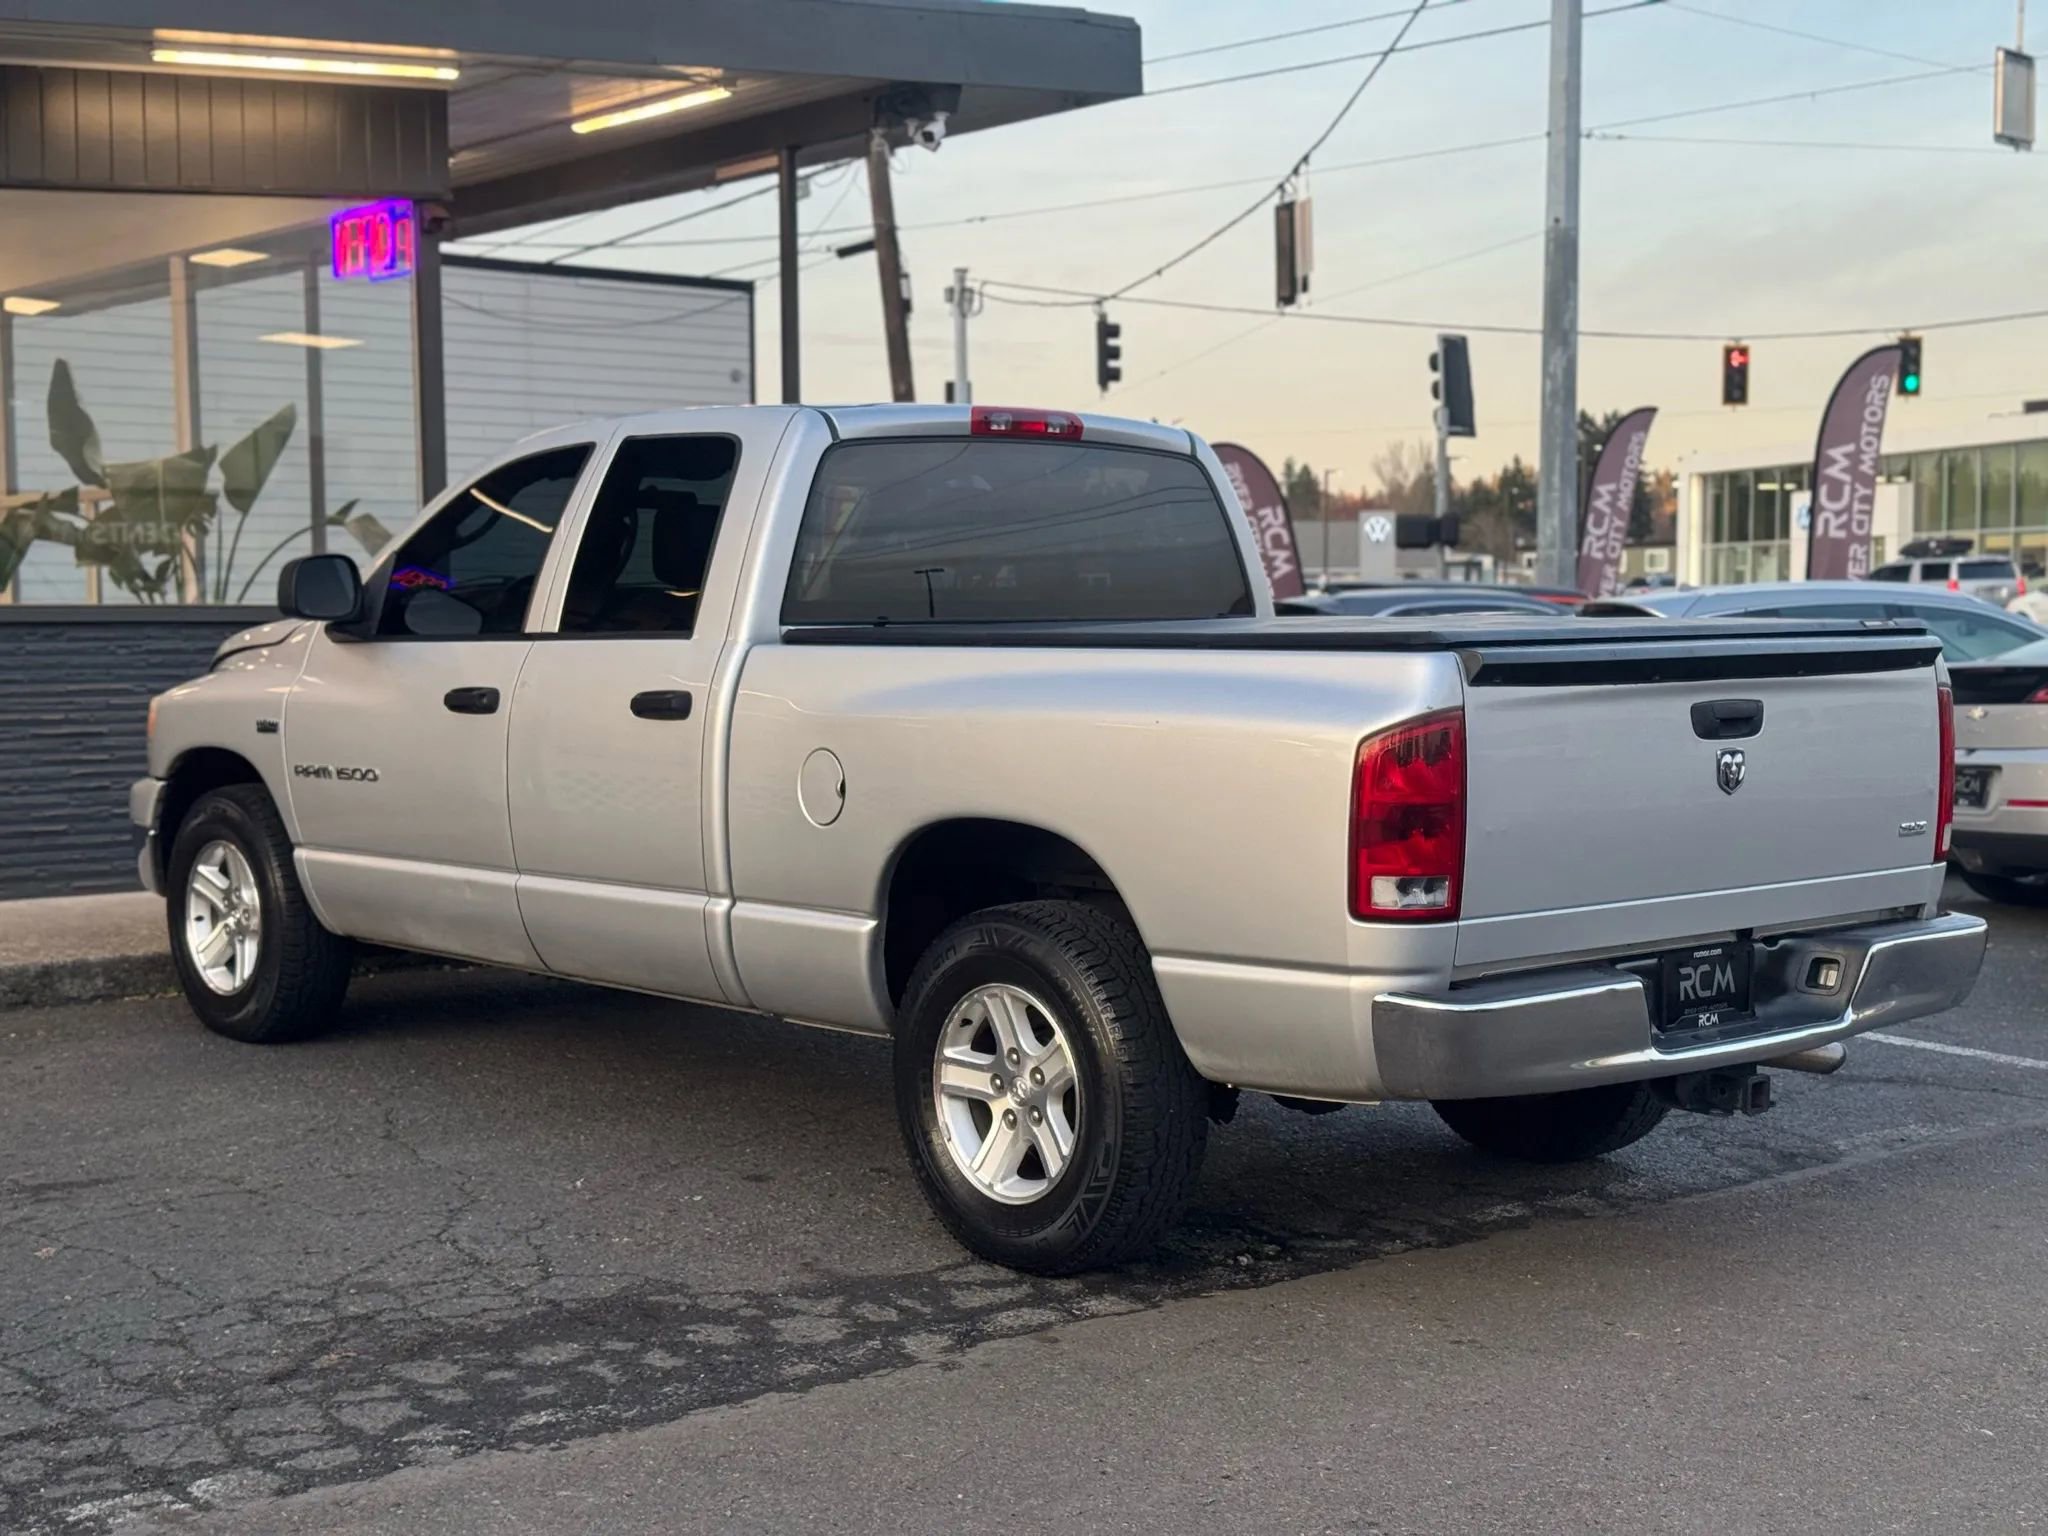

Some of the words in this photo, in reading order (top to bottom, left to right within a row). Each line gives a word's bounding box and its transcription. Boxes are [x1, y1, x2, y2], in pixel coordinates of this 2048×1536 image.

[1858, 374, 1889, 476] MOTORS
[1581, 481, 1618, 561] RCM
[1605, 515, 1626, 559] CITY
[1616, 430, 1647, 512] MOTORS
[1816, 441, 1856, 539] RCM
[1851, 483, 1873, 536] CITY
[1256, 505, 1295, 580] RCM
[294, 764, 333, 780] RAM
[336, 767, 379, 783] 1500
[1678, 960, 1736, 1001] RCM
[1698, 1013, 1719, 1028] RCM
